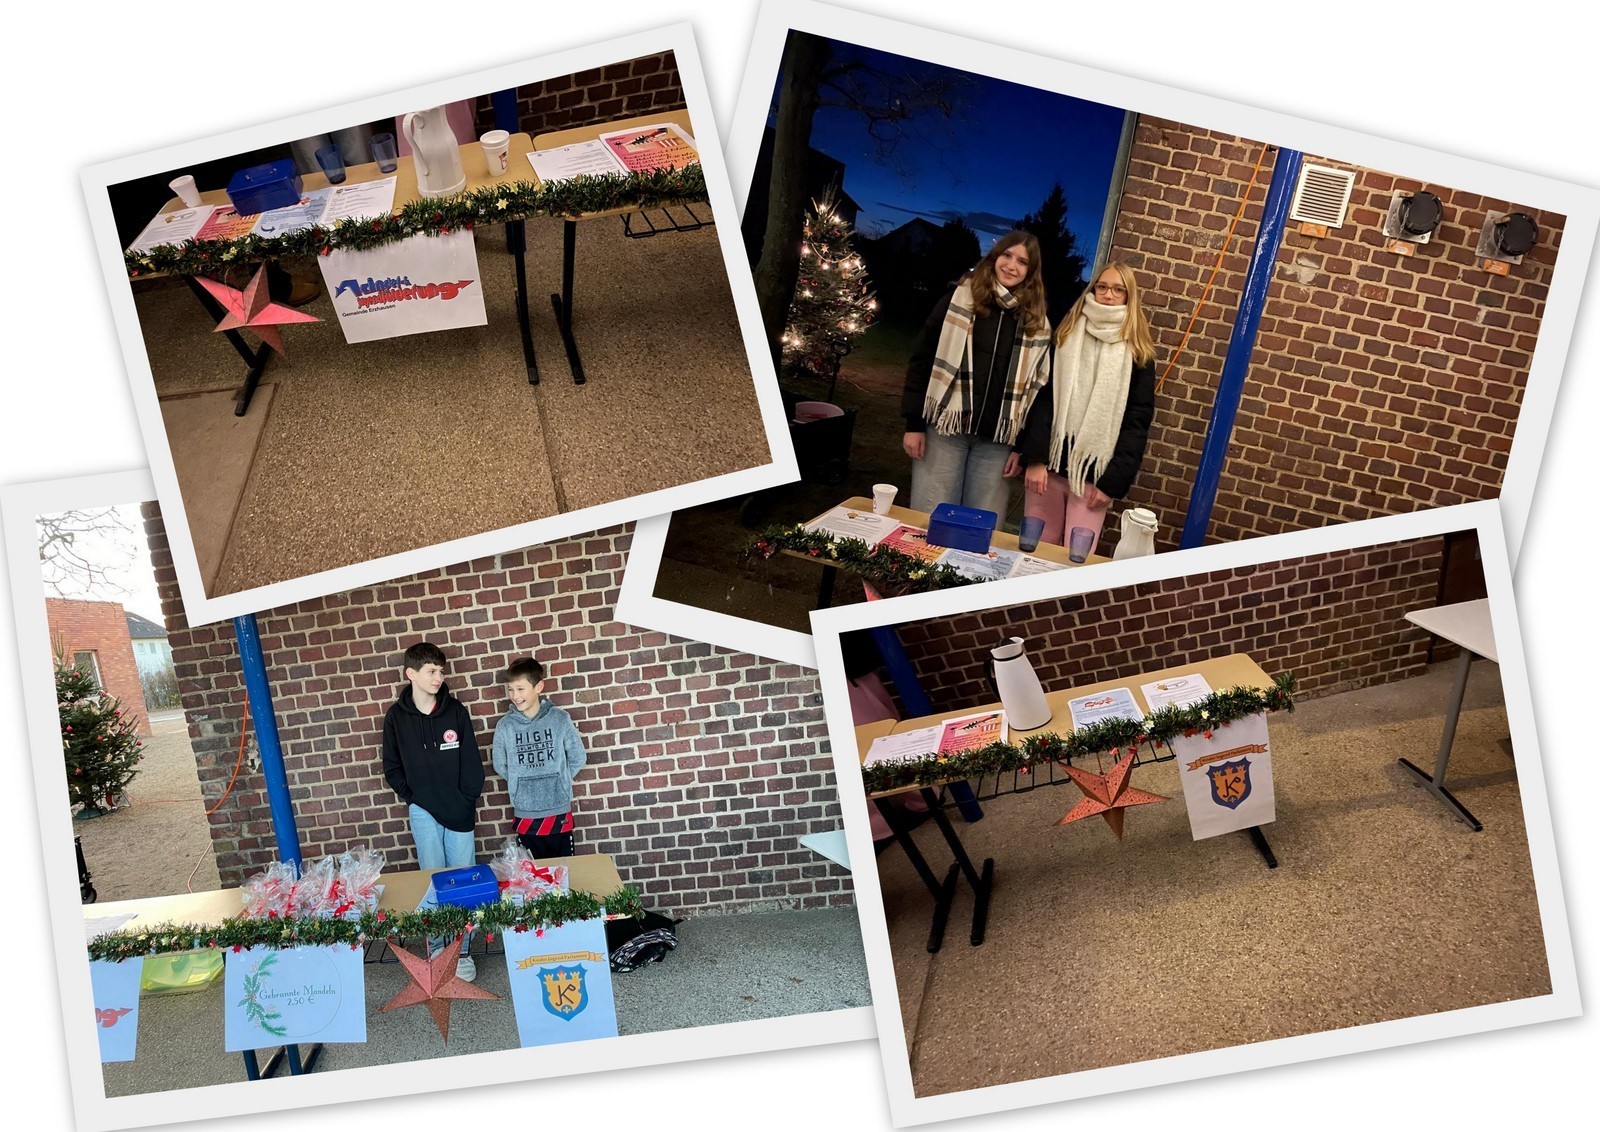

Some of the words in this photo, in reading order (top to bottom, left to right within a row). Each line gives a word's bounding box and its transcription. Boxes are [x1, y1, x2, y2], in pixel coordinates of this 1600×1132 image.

[342, 309, 368, 318] Gemeinde
[369, 303, 397, 313] Erzhausen
[515, 728, 553, 745] HIGH
[518, 749, 555, 765] ROCK
[259, 987, 300, 1000] Gebrannte
[303, 985, 336, 997] Mandeln
